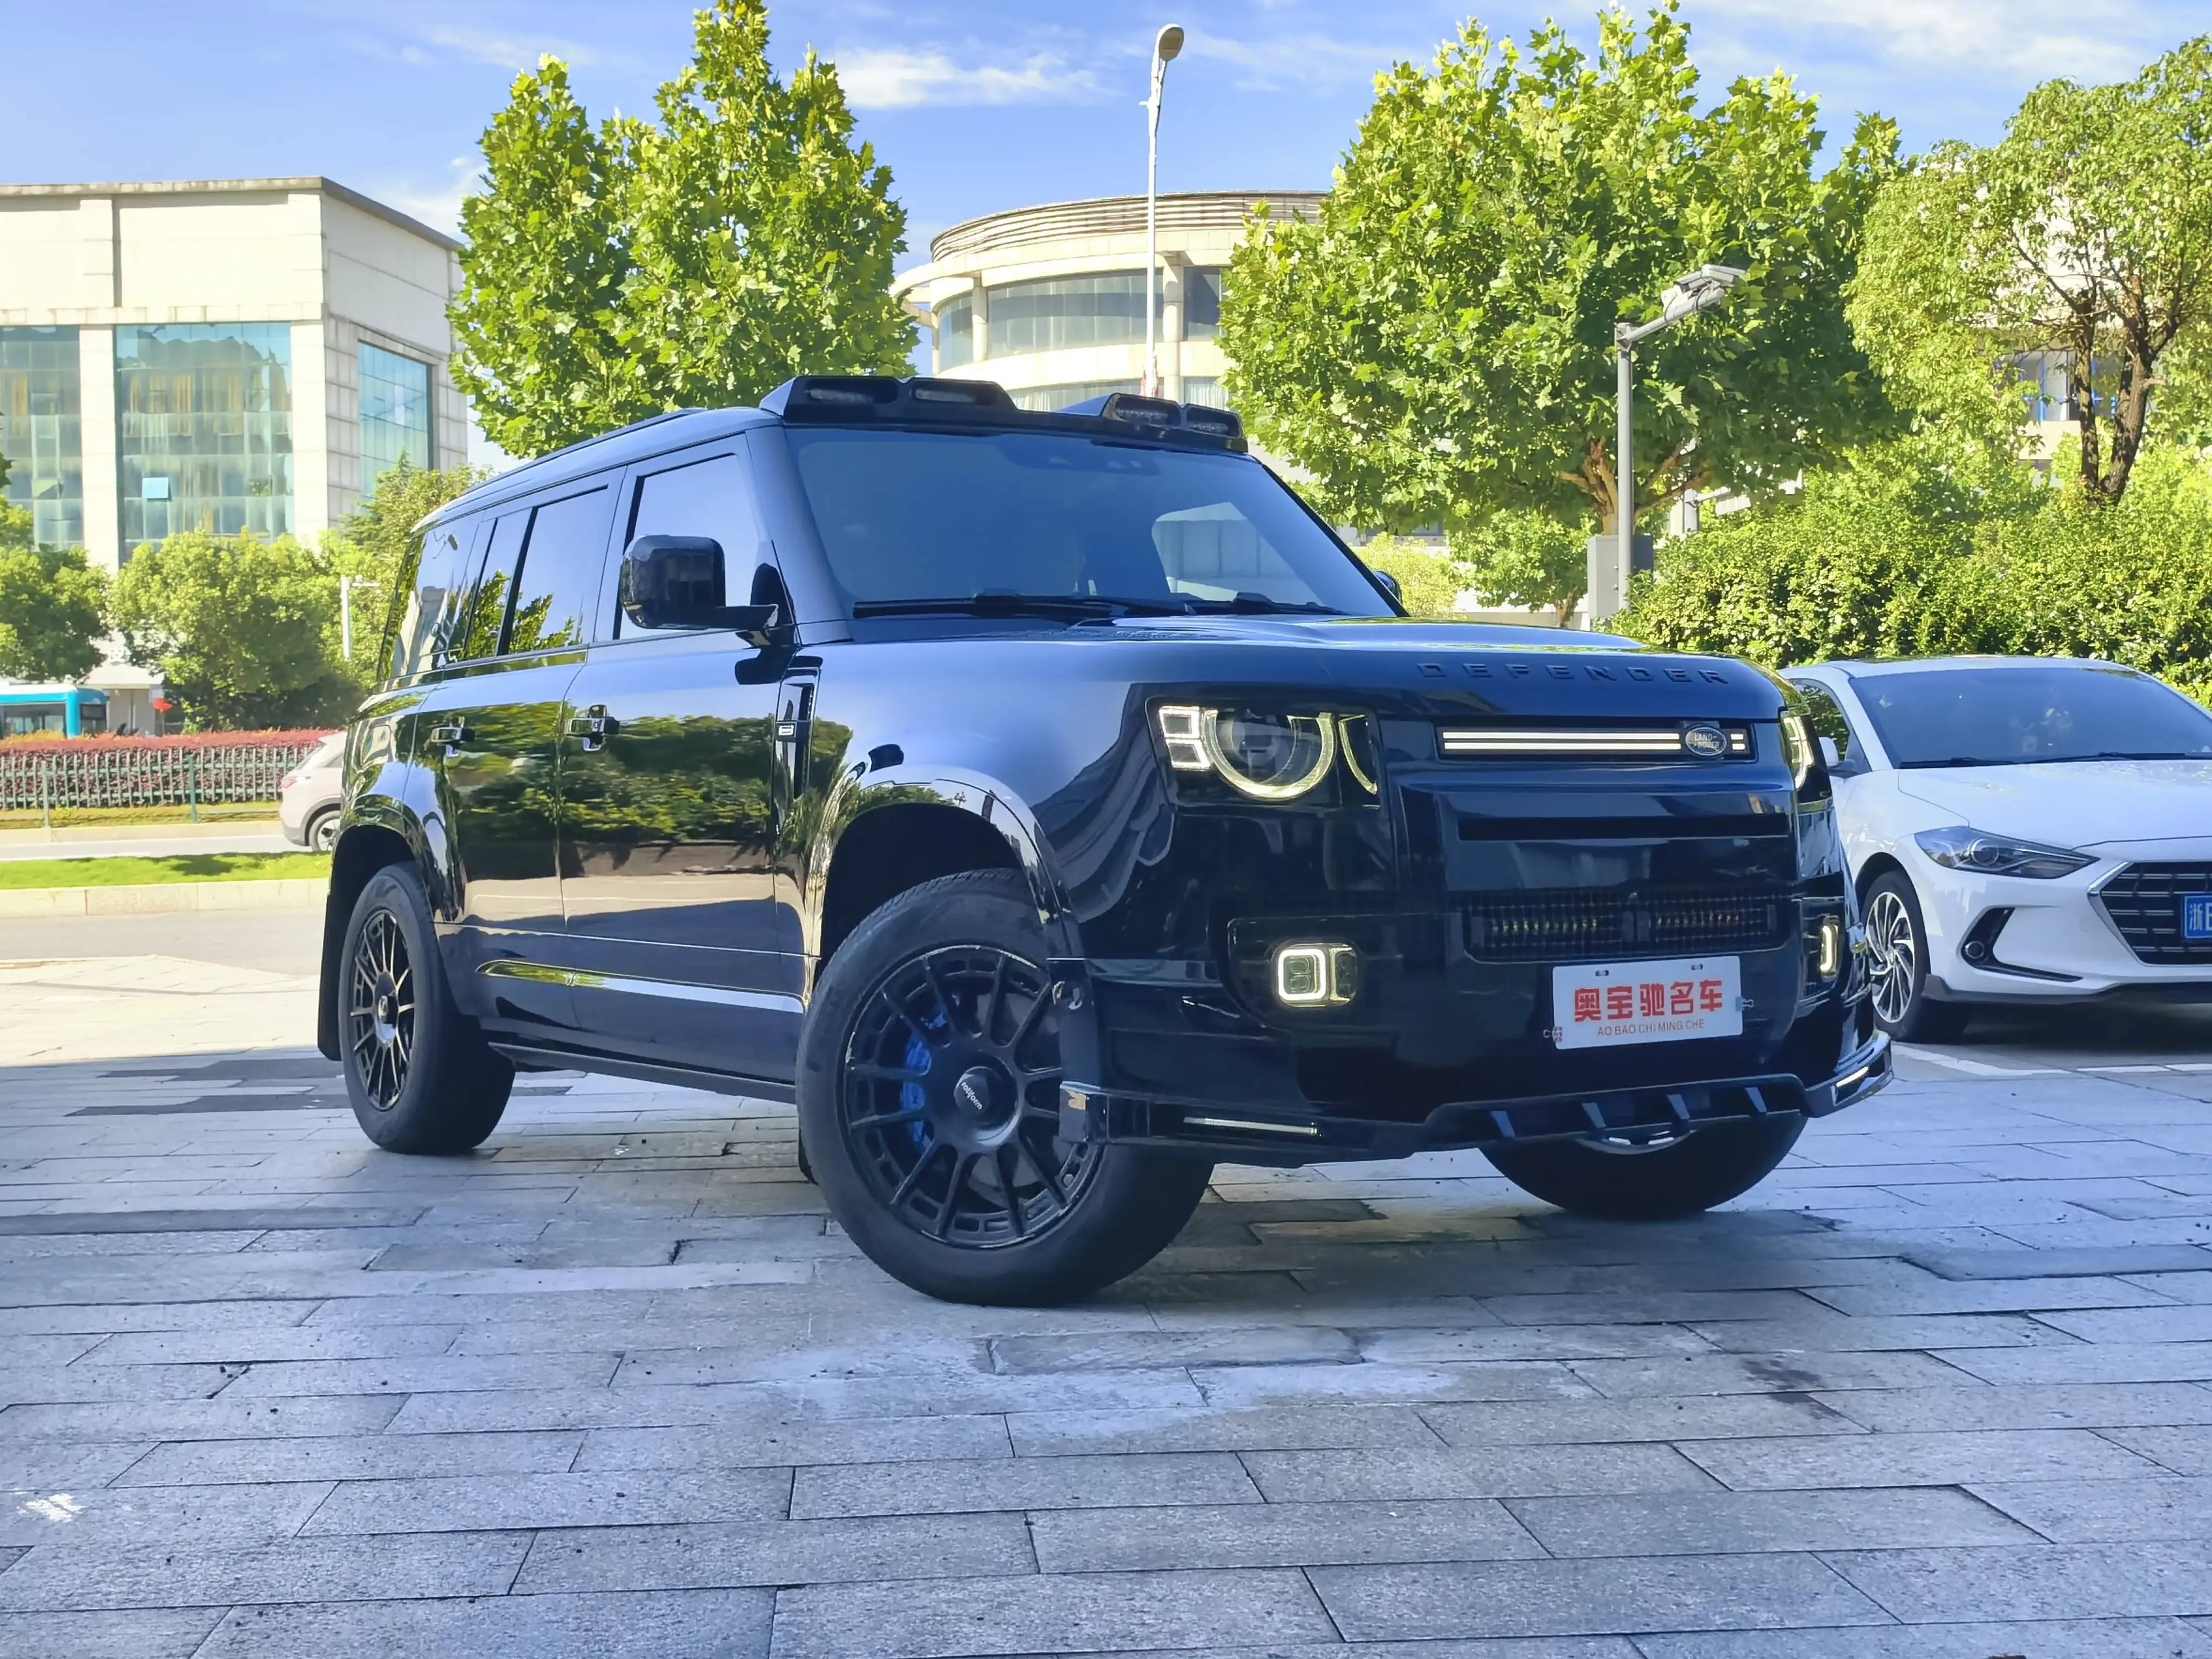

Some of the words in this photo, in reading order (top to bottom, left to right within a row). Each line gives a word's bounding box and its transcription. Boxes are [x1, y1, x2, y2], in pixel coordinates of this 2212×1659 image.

[1417, 663, 1729, 684] DEFENDER
[1574, 980, 1723, 1022] 奥宝驰名车
[1597, 1026, 1612, 1036] AO
[1615, 1024, 1636, 1035] BAO
[1638, 1023, 1655, 1033] CHI
[1658, 1021, 1683, 1032] MING
[1685, 1019, 1704, 1030] CHE
[961, 1082, 983, 1110] rotiform
